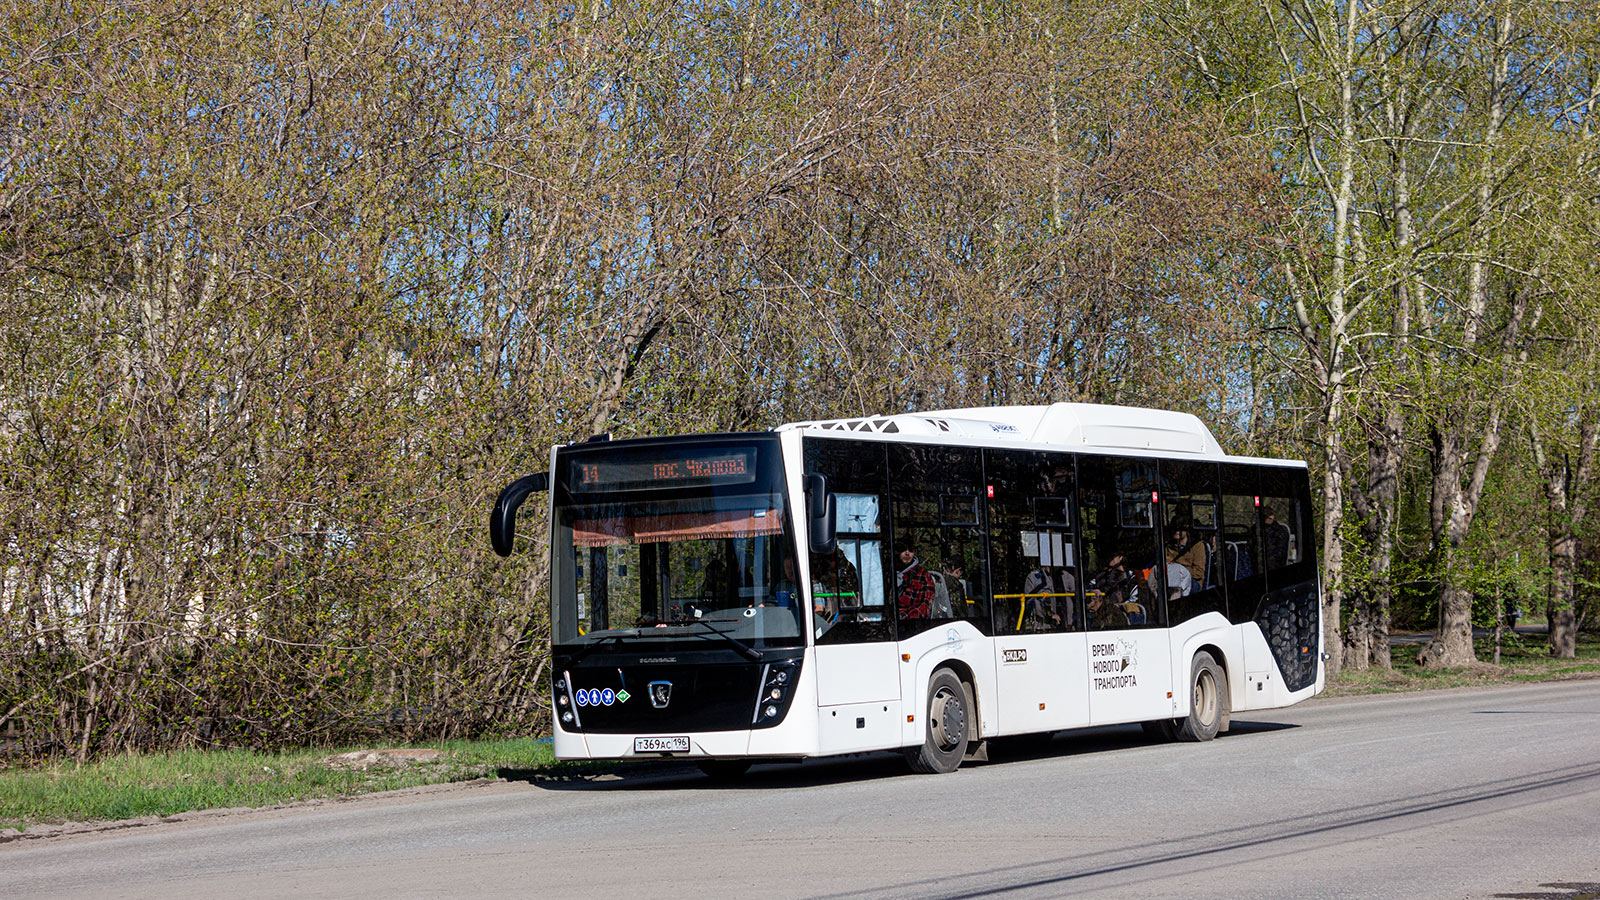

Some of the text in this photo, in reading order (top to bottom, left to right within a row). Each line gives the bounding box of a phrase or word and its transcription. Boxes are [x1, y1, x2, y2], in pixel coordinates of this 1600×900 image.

[583, 465, 599, 483] 14
[1092, 643, 1115, 657] ВРЕМЯ
[1093, 659, 1120, 673] НОВОГО
[1093, 674, 1137, 690] ТРАНСПОРТА
[673, 738, 688, 746] 196
